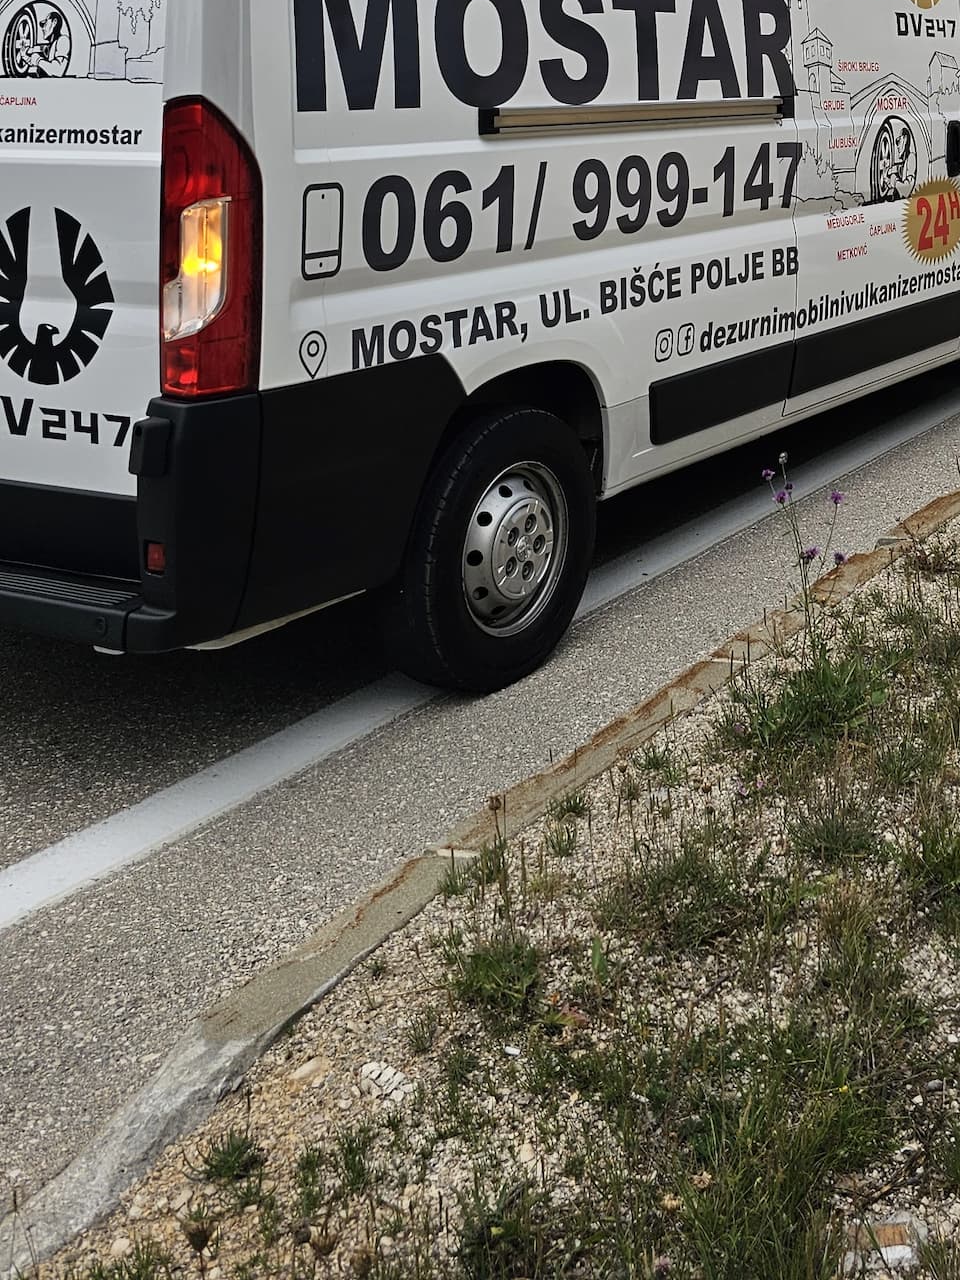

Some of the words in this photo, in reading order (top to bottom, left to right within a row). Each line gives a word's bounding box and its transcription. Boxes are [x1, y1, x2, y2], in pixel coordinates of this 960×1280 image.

[895, 12, 955, 38] DV247
[877, 98, 907, 111] MOSTAR
[362, 161, 547, 272] 061/
[572, 142, 802, 241] 999-147
[916, 190, 960, 251] 24H
[351, 301, 528, 369] MOSTAR,
[539, 288, 590, 327] UL.
[600, 262, 681, 314] BIŠĆE
[691, 253, 764, 294] POLJE
[773, 246, 799, 277] BB
[0, 395, 131, 447] V247
